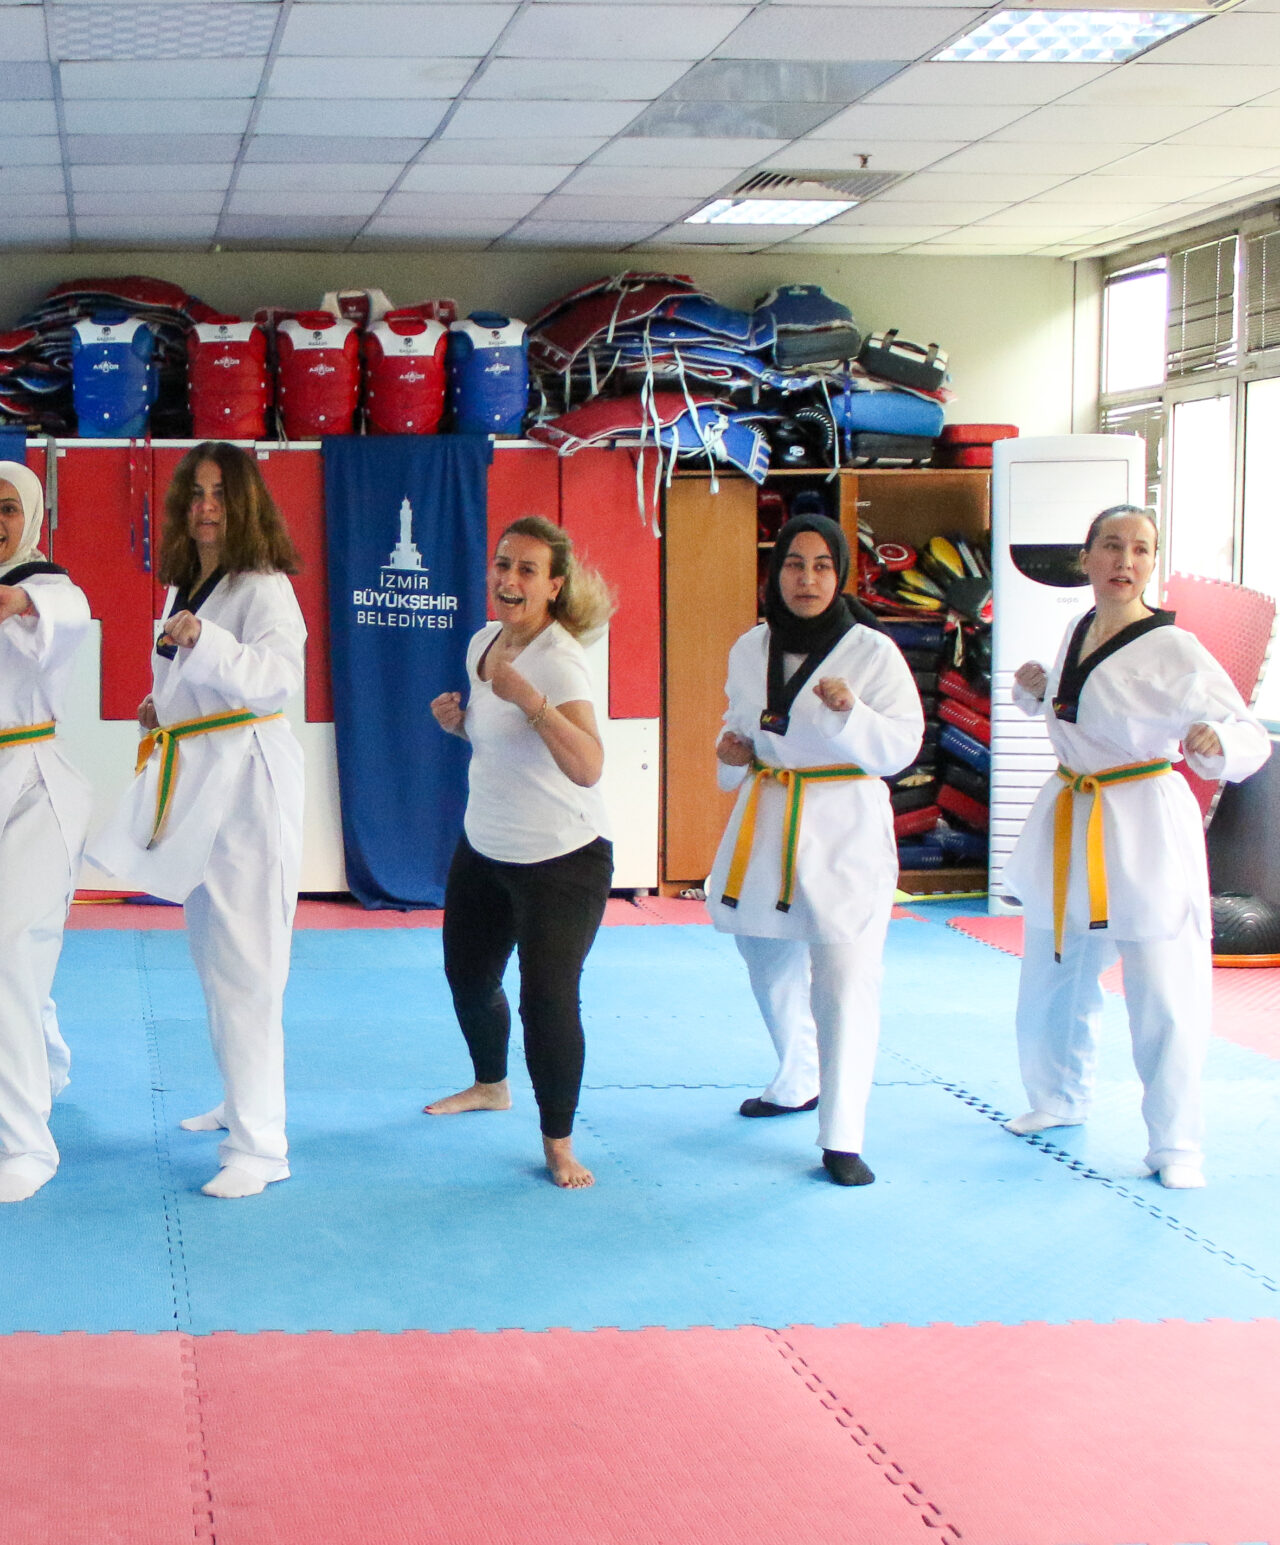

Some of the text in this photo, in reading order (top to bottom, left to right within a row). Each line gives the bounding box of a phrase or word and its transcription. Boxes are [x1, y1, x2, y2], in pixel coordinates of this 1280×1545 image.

[380, 572, 429, 589] İZMİR
[353, 588, 458, 611] BÜYÜKŞEHİR
[357, 611, 453, 628] BELEDİYESİ
